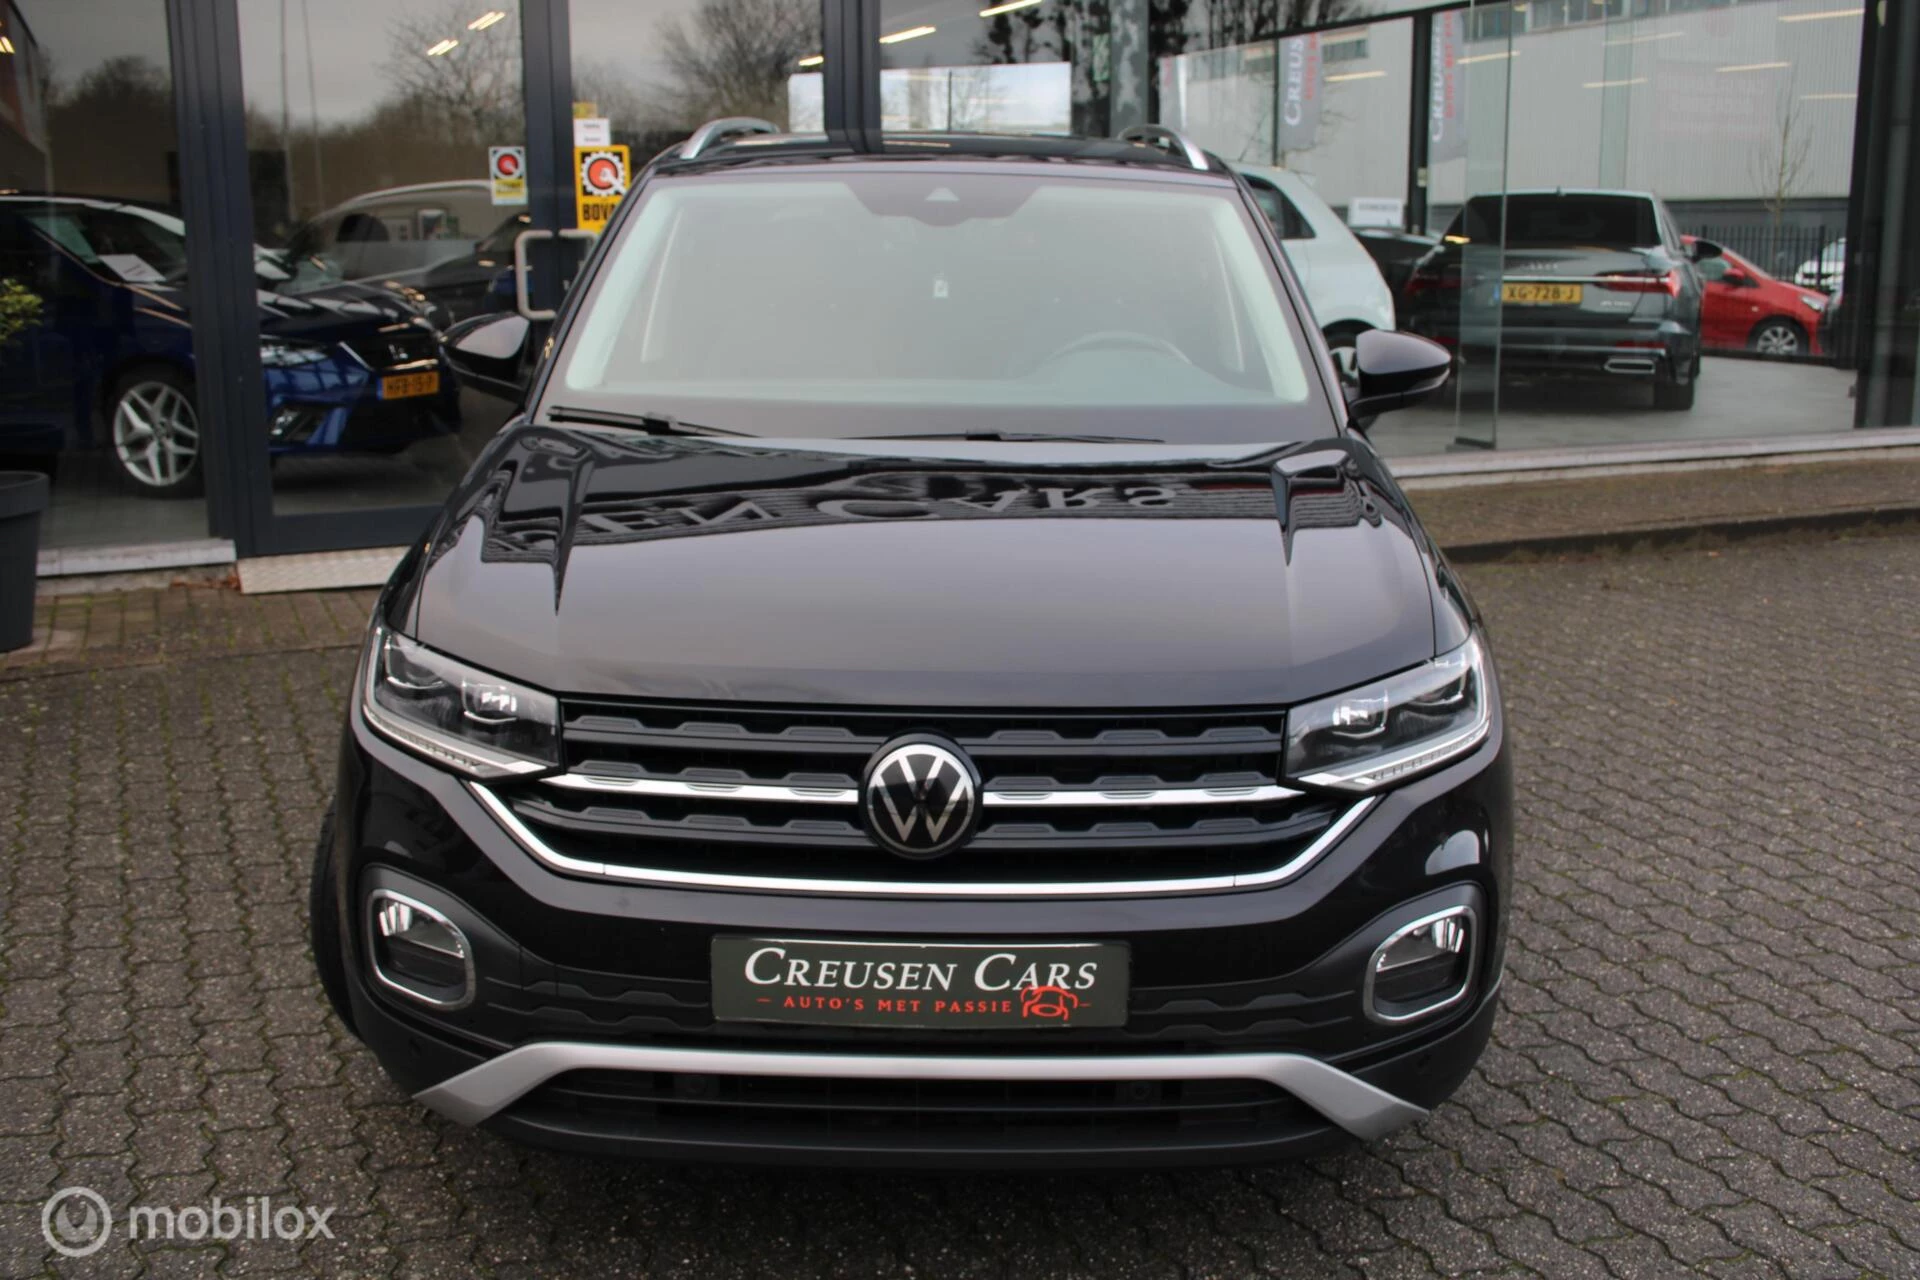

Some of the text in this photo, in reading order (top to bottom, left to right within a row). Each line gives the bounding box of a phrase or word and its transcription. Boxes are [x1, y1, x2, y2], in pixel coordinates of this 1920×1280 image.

[744, 947, 1097, 992] CREUSEN CARS
[784, 996, 1012, 1013] AUTO'S MET PASSIE
